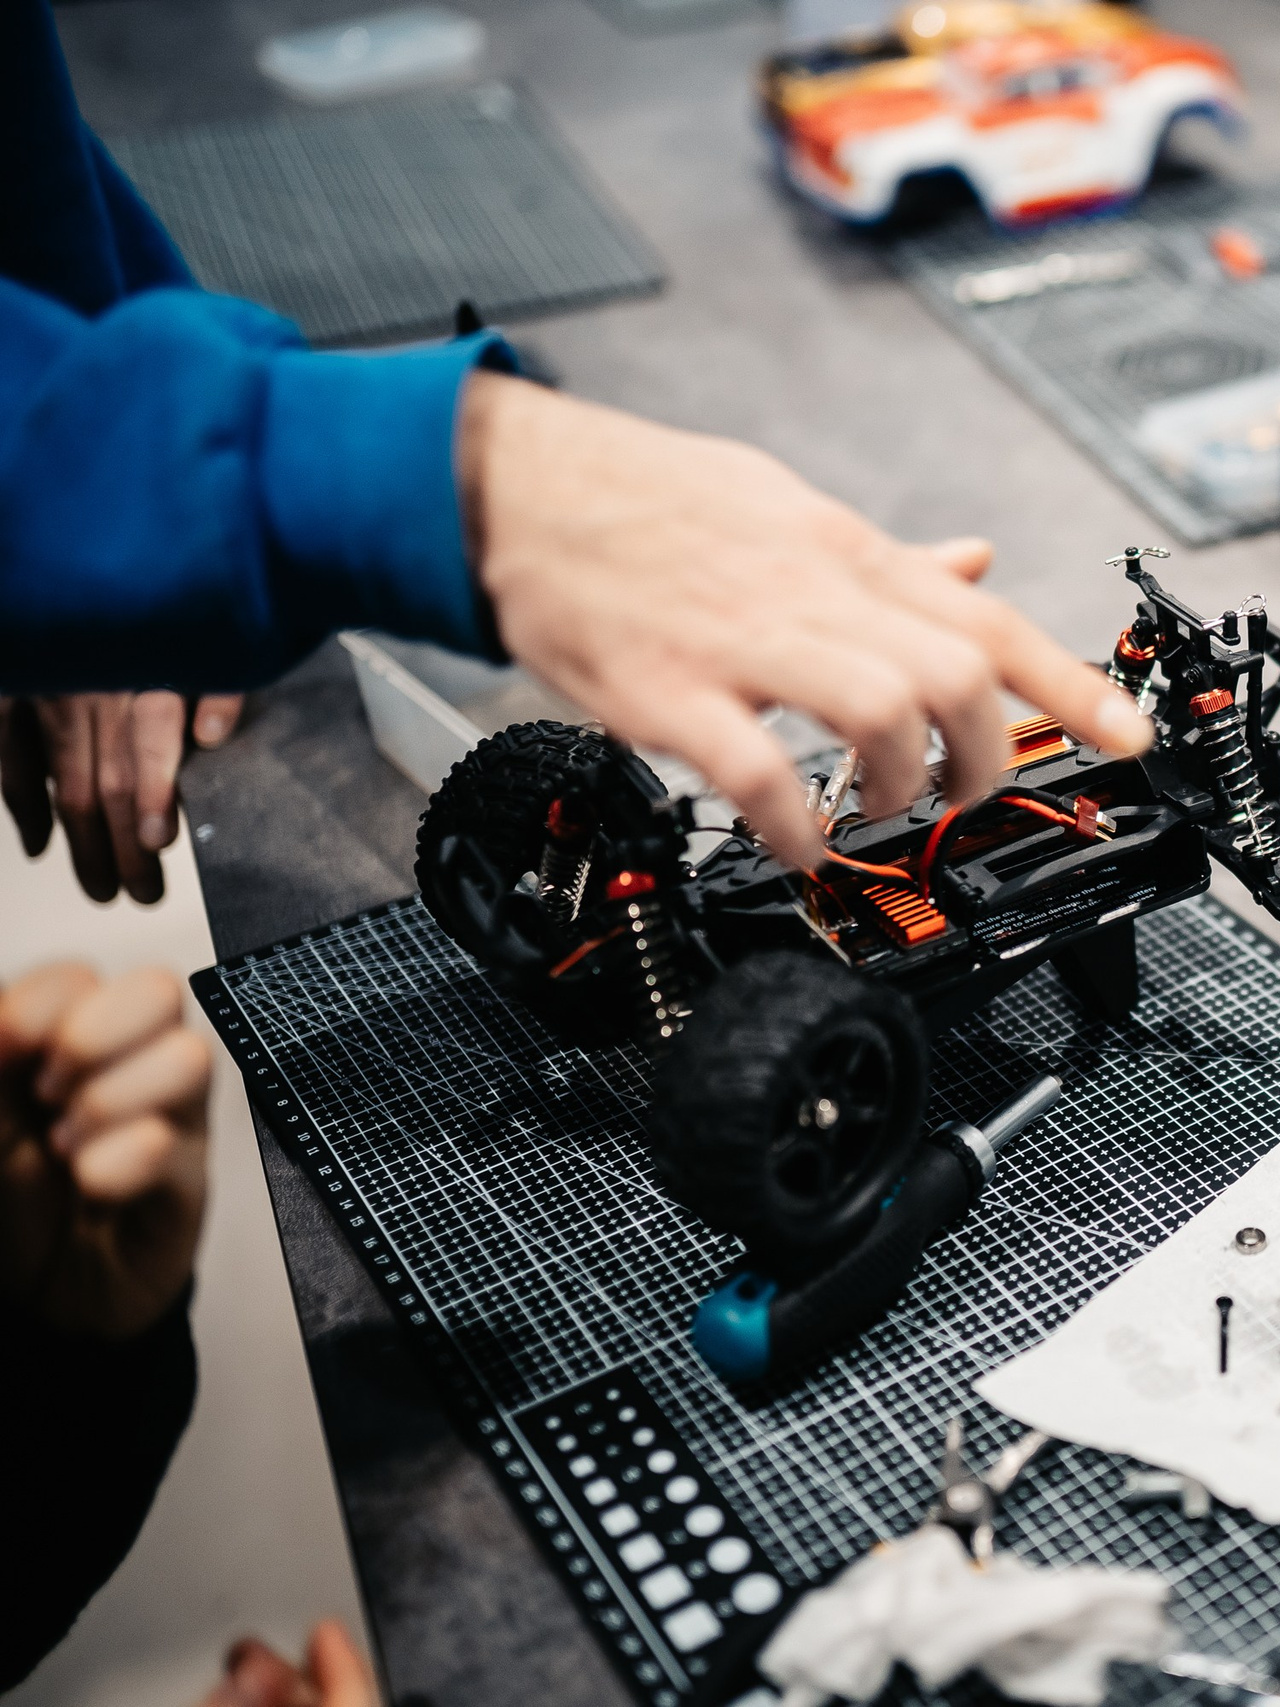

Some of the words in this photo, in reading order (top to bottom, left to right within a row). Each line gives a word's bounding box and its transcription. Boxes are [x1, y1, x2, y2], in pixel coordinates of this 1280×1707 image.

[298, 1132, 310, 1141] 10
[306, 1147, 319, 1156] 11
[318, 1165, 332, 1176] 12
[328, 1181, 342, 1192] 13
[339, 1199, 354, 1210] 14
[350, 1216, 365, 1227] 15
[363, 1237, 378, 1249] 16
[374, 1254, 390, 1264] 17
[385, 1272, 401, 1284] 18
[399, 1294, 415, 1305] 19
